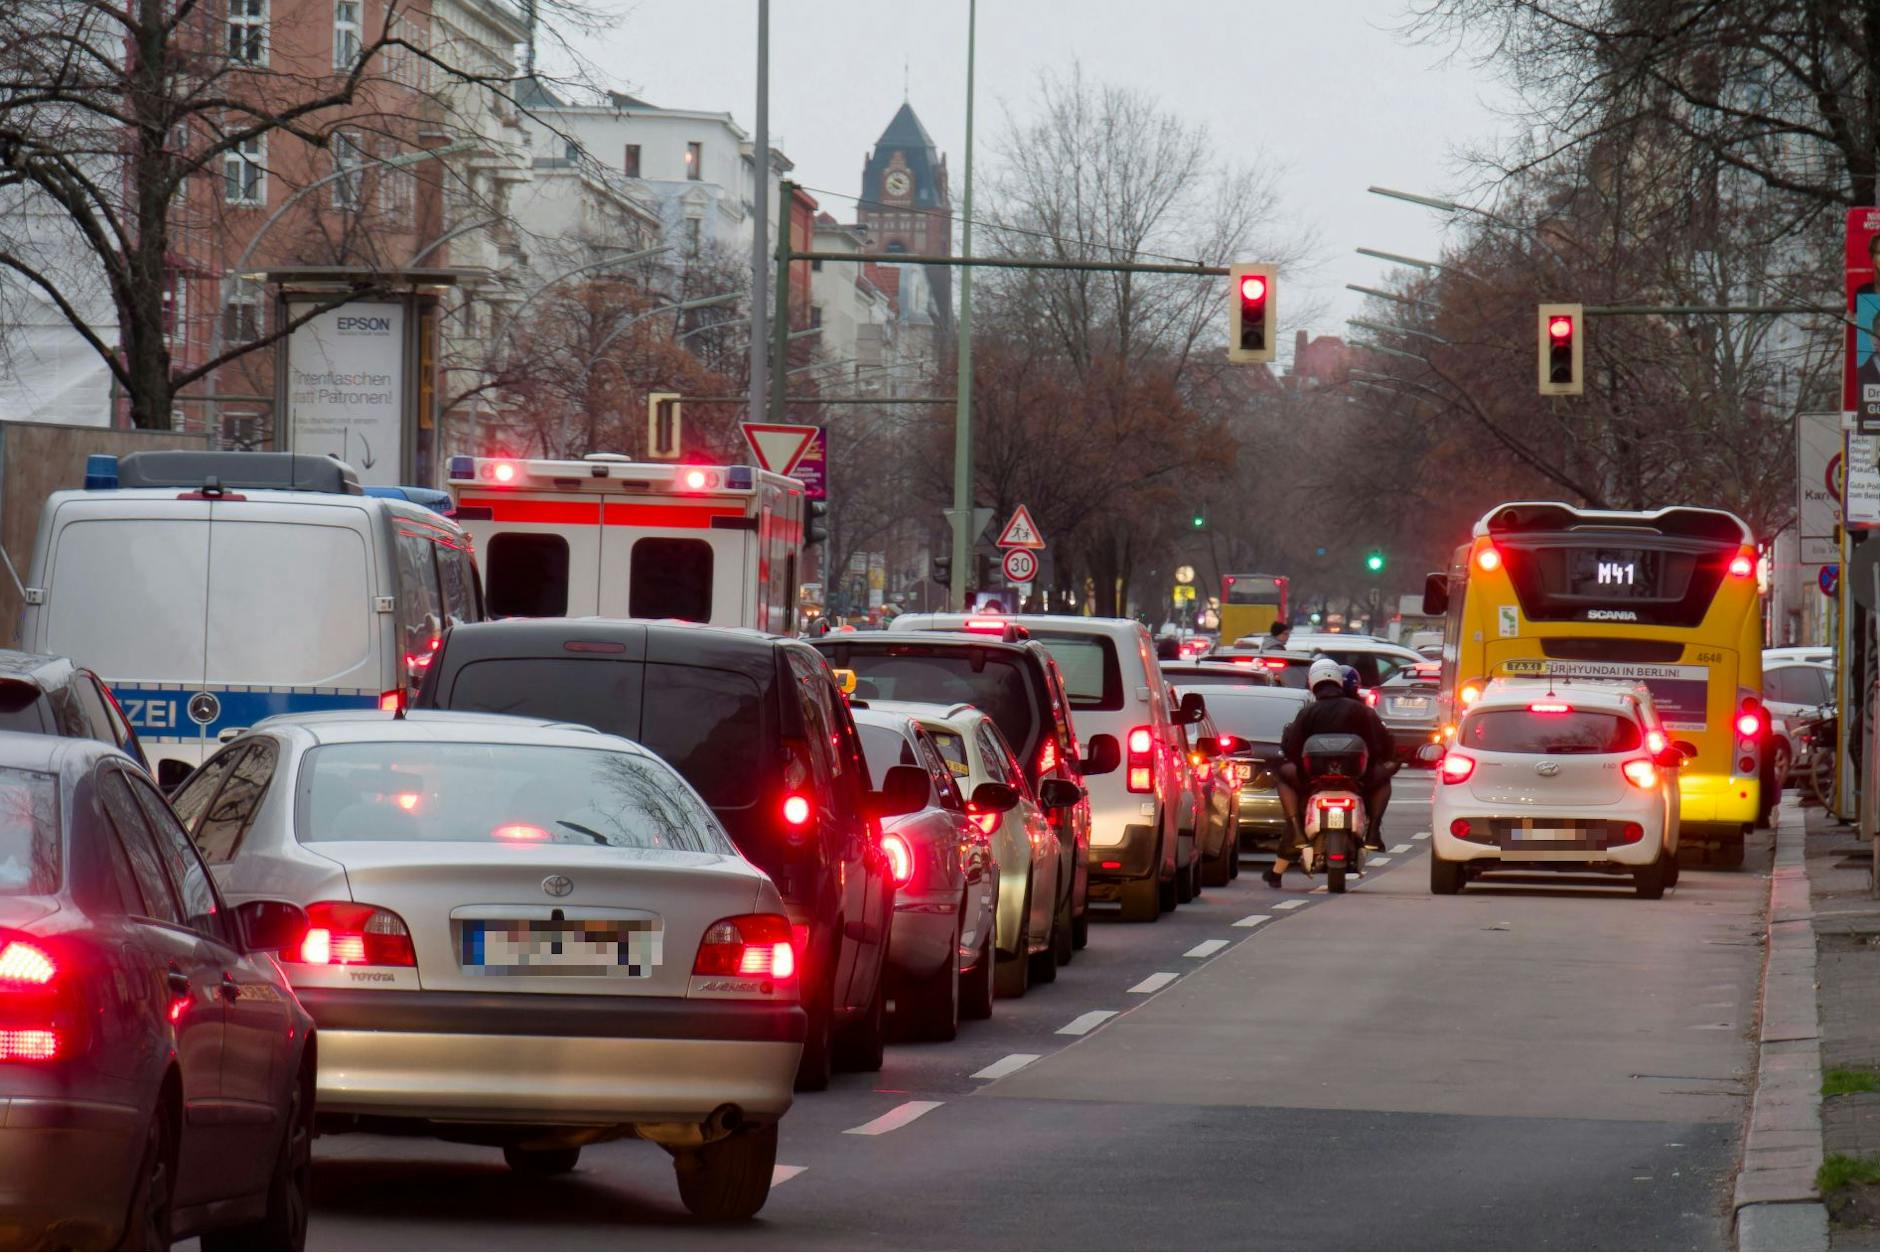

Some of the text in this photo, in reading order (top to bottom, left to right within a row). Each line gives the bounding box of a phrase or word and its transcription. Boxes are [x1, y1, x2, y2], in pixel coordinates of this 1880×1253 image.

[337, 317, 390, 331] EPSON
[319, 388, 392, 405] Patronen!
[1011, 557, 1030, 572] 30
[1598, 562, 1634, 585] M41
[1588, 609, 1637, 620] SCANIA
[1545, 662, 1680, 678] FÜR HYUNDAI IN BERLIN!
[119, 699, 176, 728] ZEI
[350, 972, 395, 982] TOYOTA
